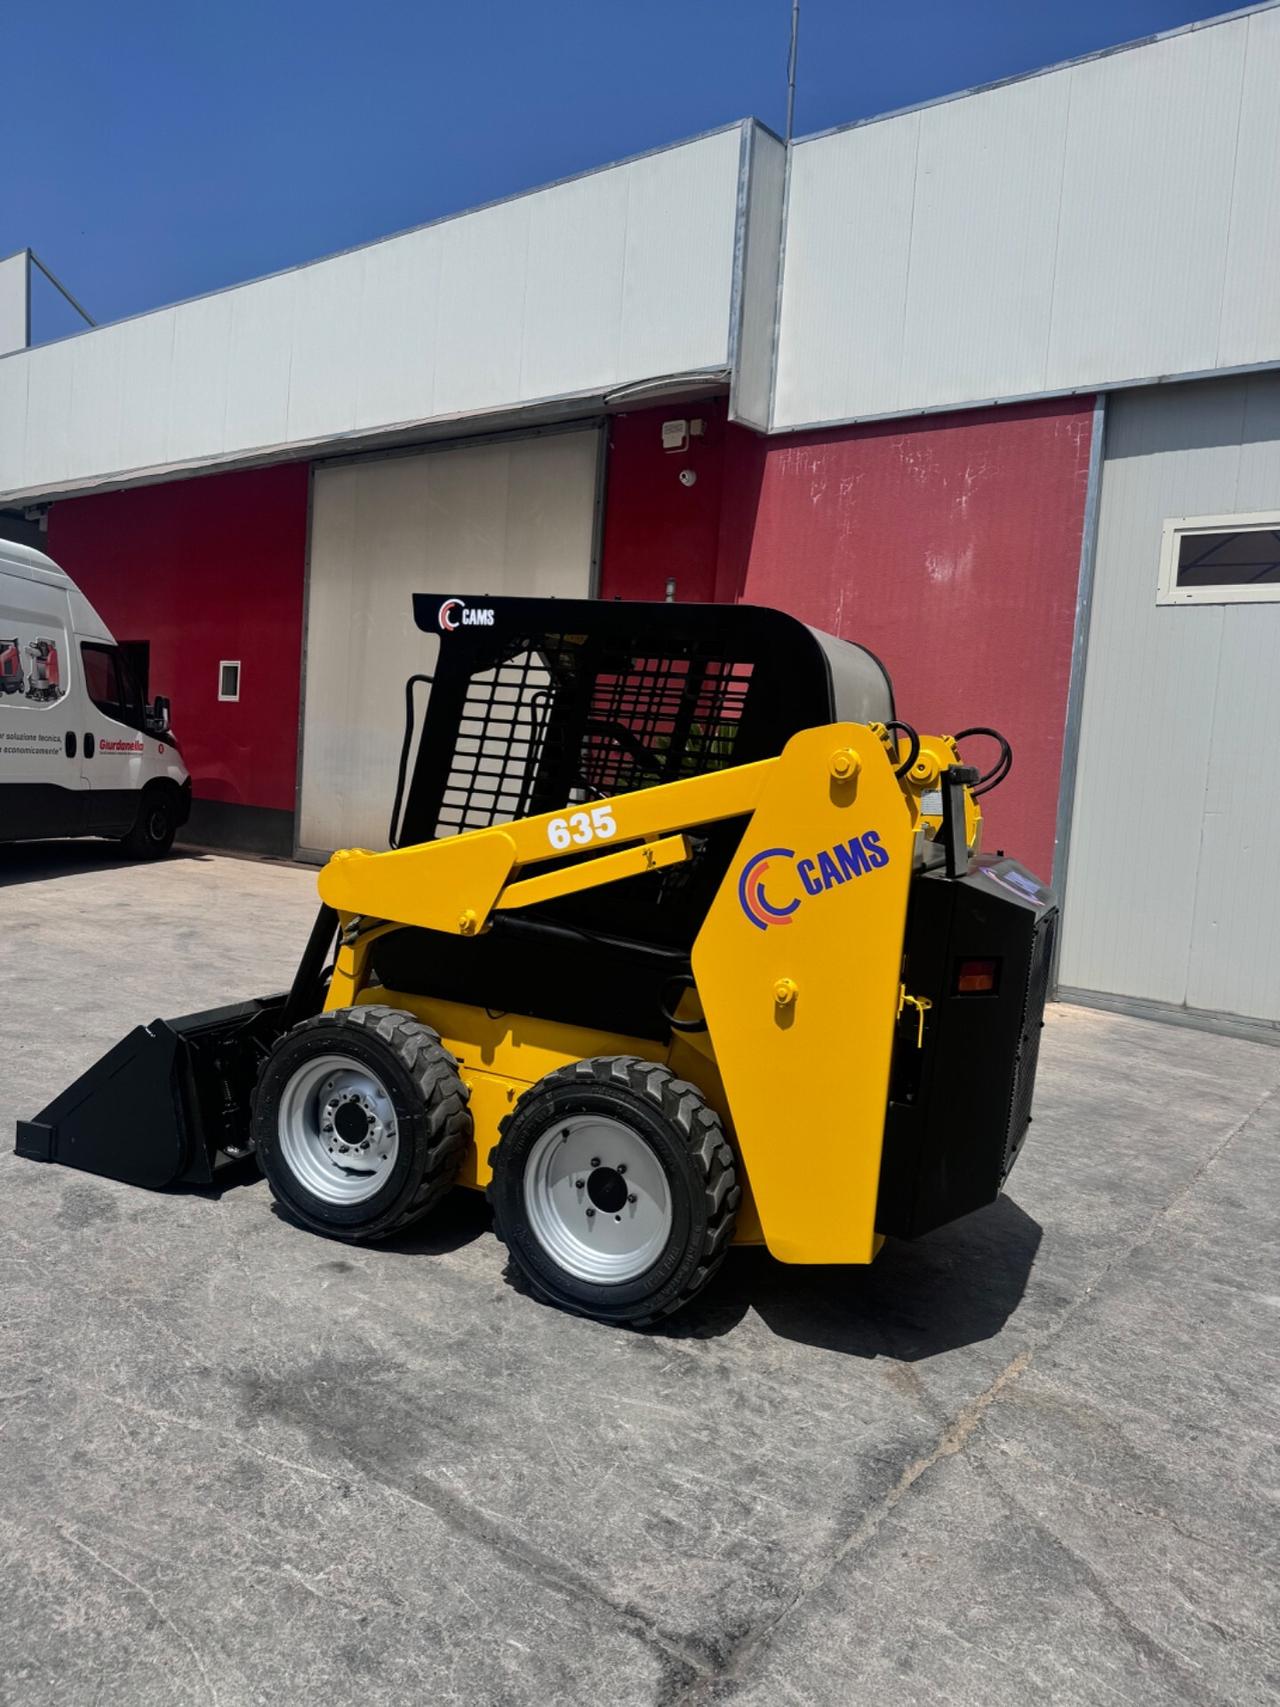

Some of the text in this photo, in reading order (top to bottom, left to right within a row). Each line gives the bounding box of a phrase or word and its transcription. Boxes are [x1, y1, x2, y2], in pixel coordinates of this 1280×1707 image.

[462, 609, 495, 626] CAMS
[6, 732, 37, 741] soluzione
[547, 806, 616, 850] 635
[797, 830, 889, 895] CAMS
